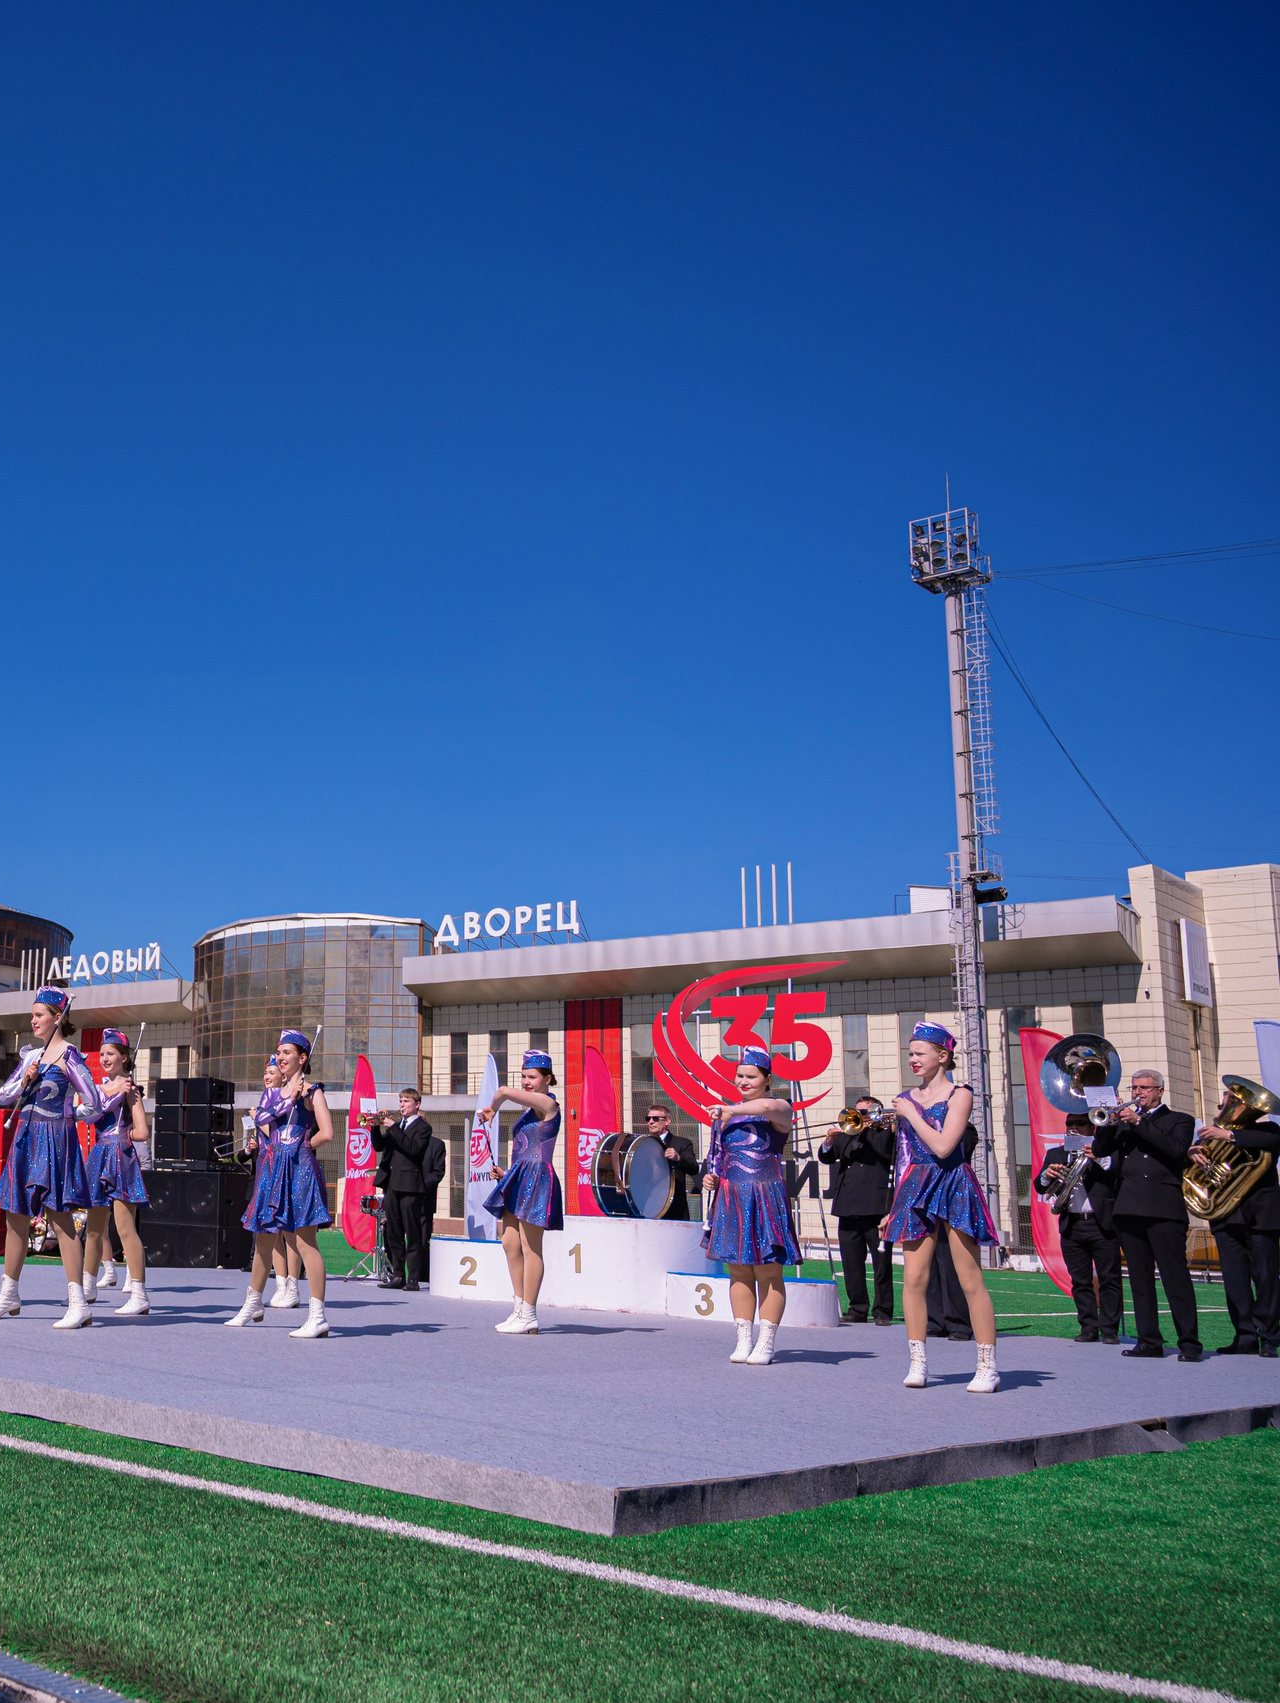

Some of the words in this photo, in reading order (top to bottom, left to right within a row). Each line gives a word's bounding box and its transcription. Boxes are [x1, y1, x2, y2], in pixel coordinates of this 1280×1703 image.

[434, 900, 580, 948] ДВОРЕЦ
[47, 942, 161, 981] ЛЕДОВЫЙ
[710, 991, 833, 1082] 35
[459, 1256, 478, 1287] 2
[568, 1243, 582, 1274] 1
[694, 1282, 715, 1316] 3
